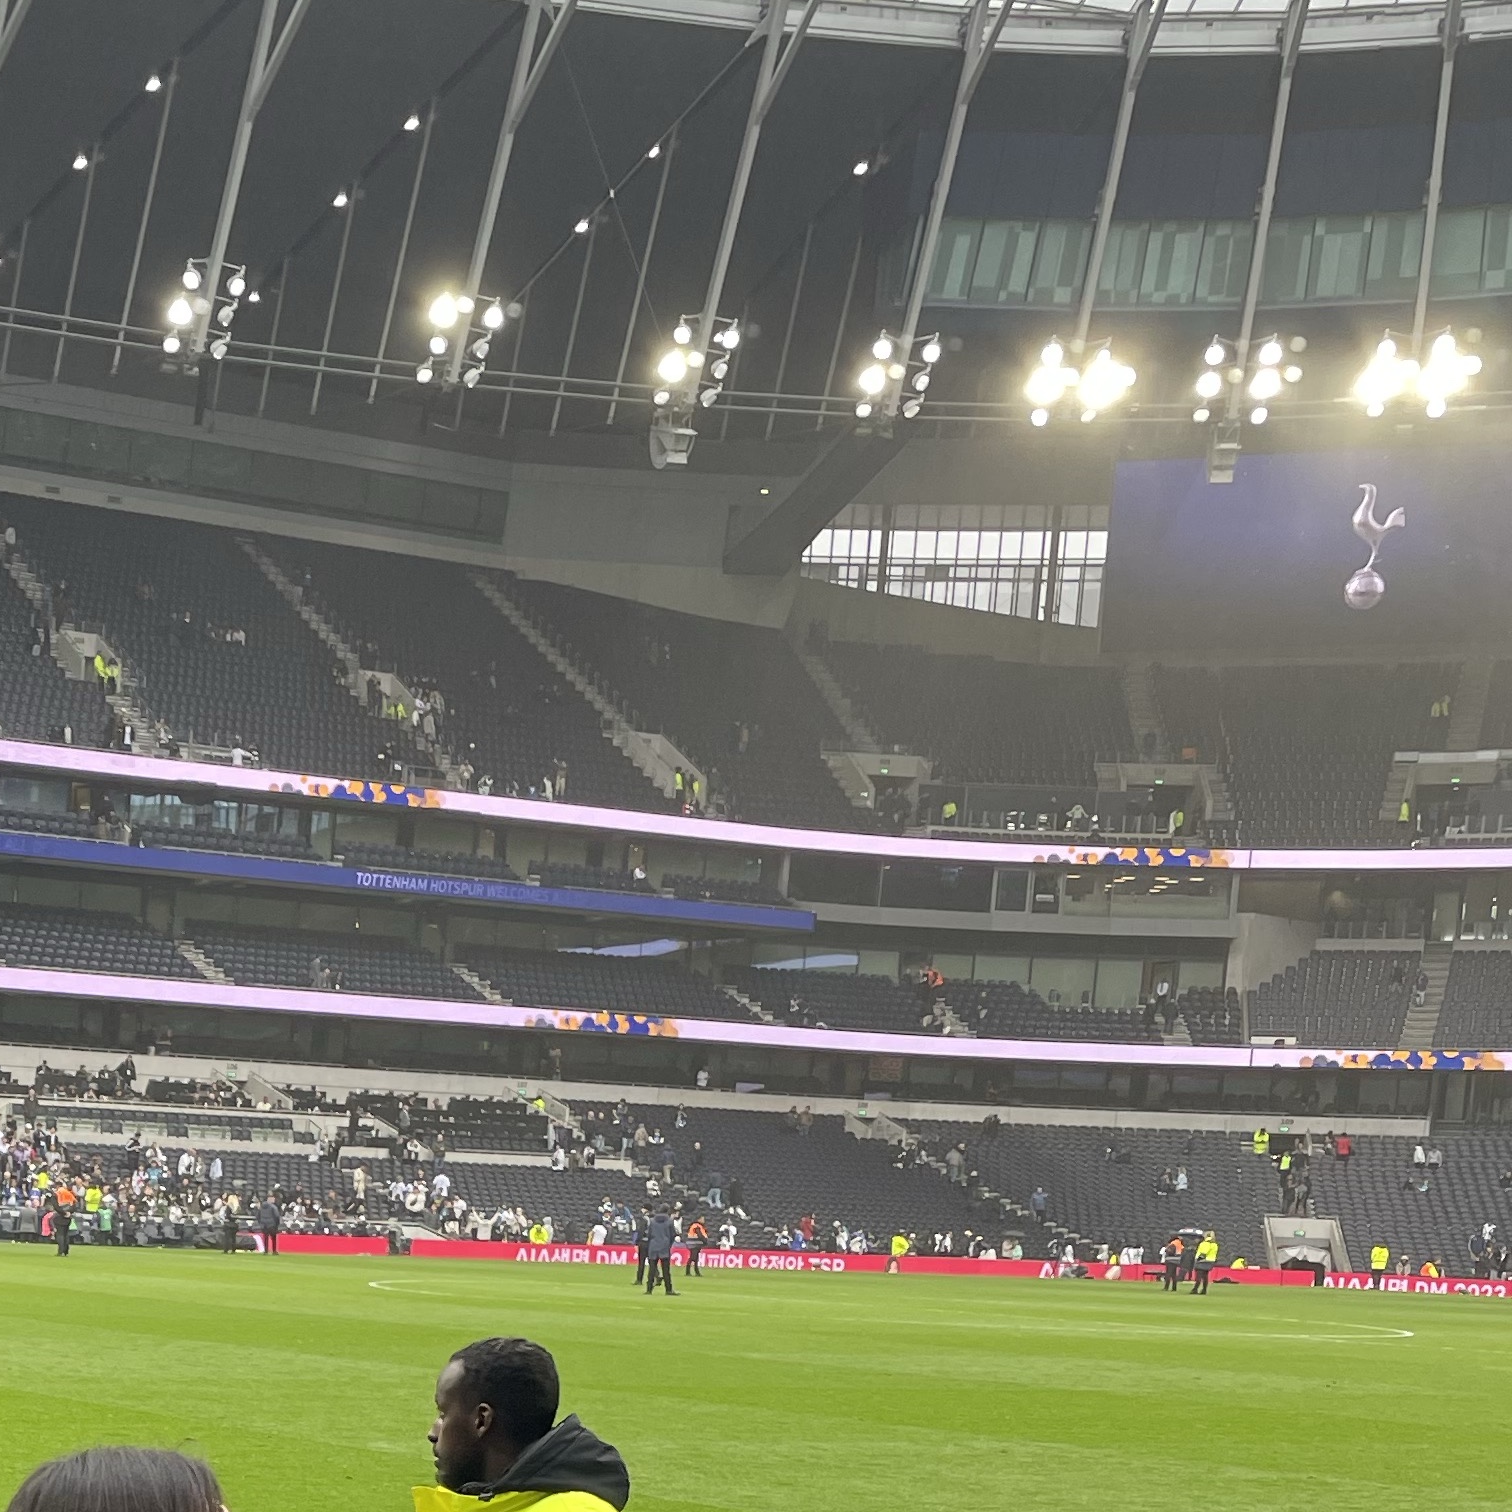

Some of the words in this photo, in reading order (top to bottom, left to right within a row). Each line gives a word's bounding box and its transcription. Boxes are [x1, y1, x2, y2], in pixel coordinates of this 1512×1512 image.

[356, 872, 428, 891] TOTTENHAM
[429, 880, 484, 897] HOTSPUR
[596, 1250, 628, 1265] DM
[1415, 1281, 1448, 1295] DM
